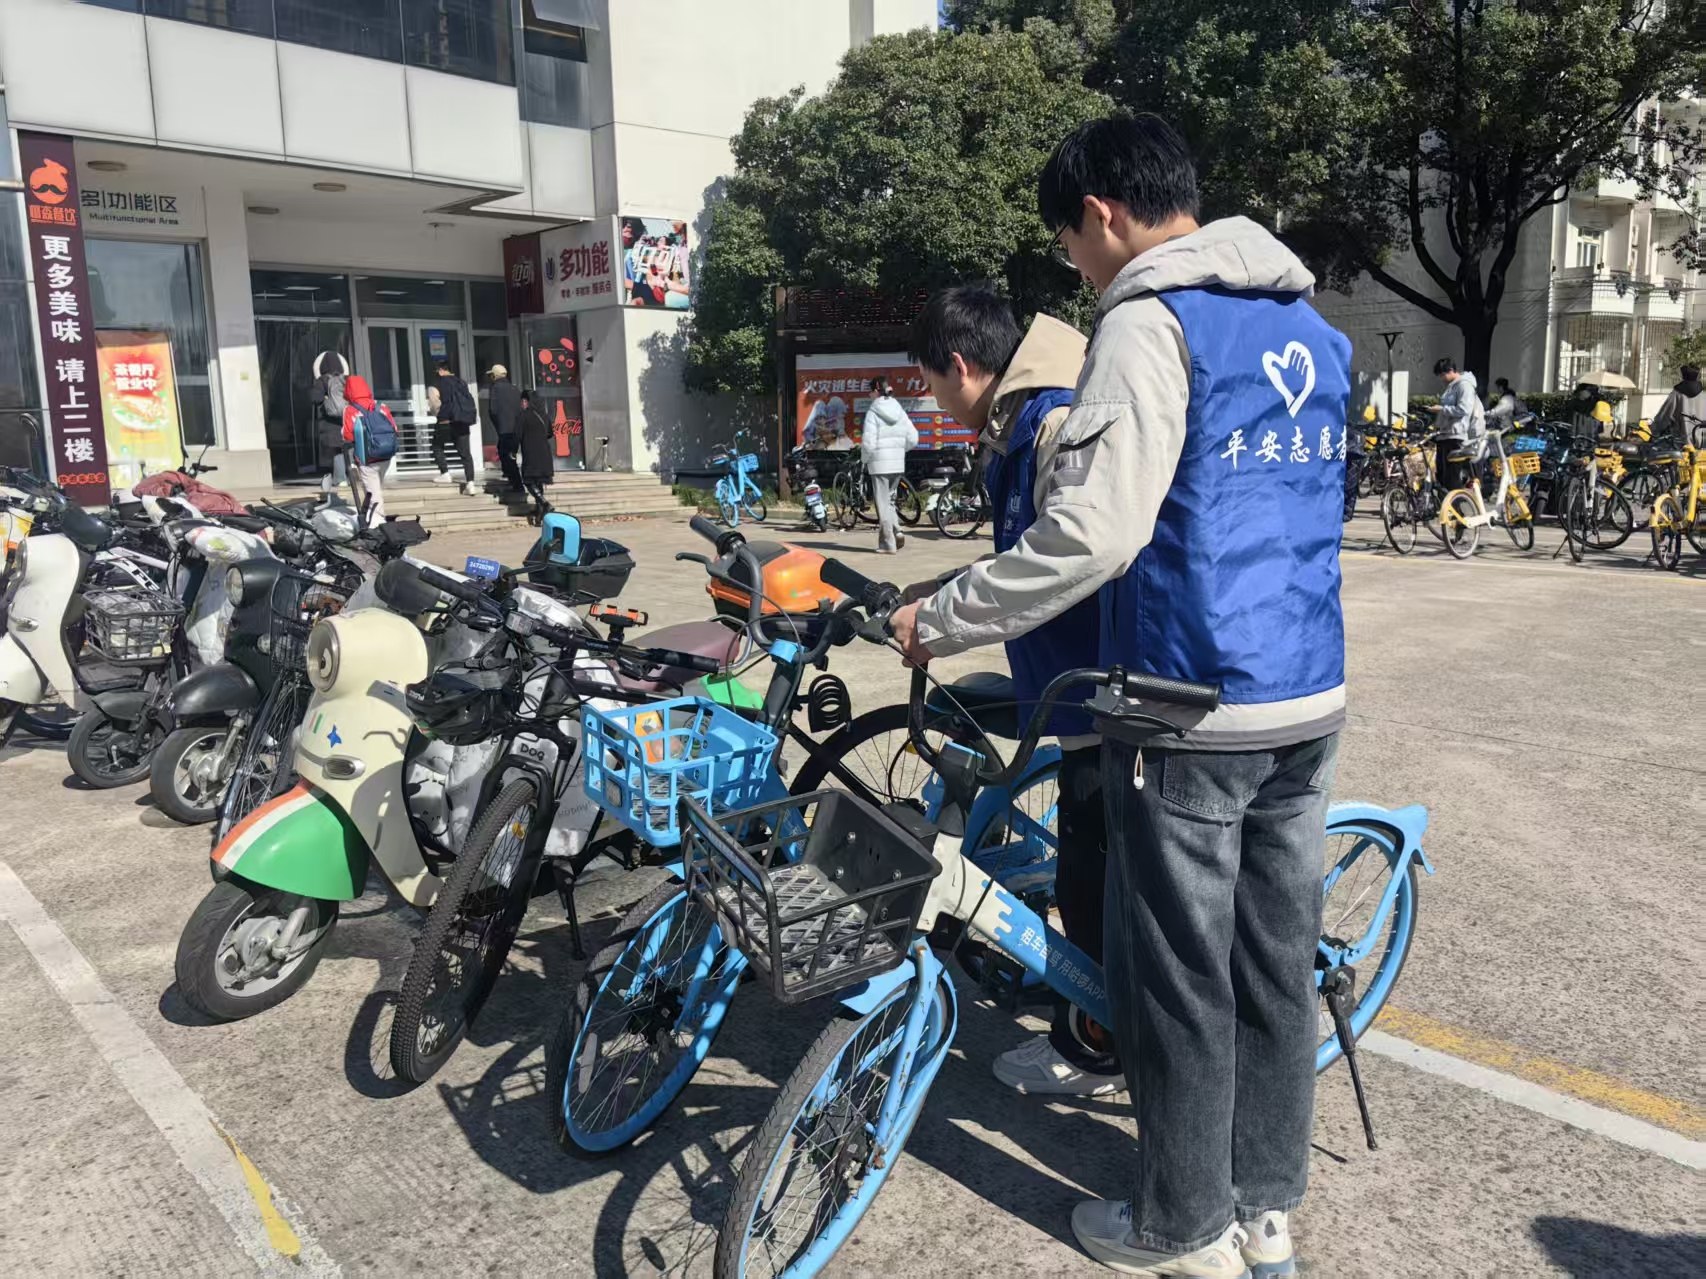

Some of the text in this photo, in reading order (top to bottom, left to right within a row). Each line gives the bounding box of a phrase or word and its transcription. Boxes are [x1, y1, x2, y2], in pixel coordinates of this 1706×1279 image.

[159, 217, 179, 225] Area
[560, 240, 610, 282] 多功能
[41, 234, 95, 464] 更多美味 请上二楼
[1019, 926, 1063, 967] 租车自驾
